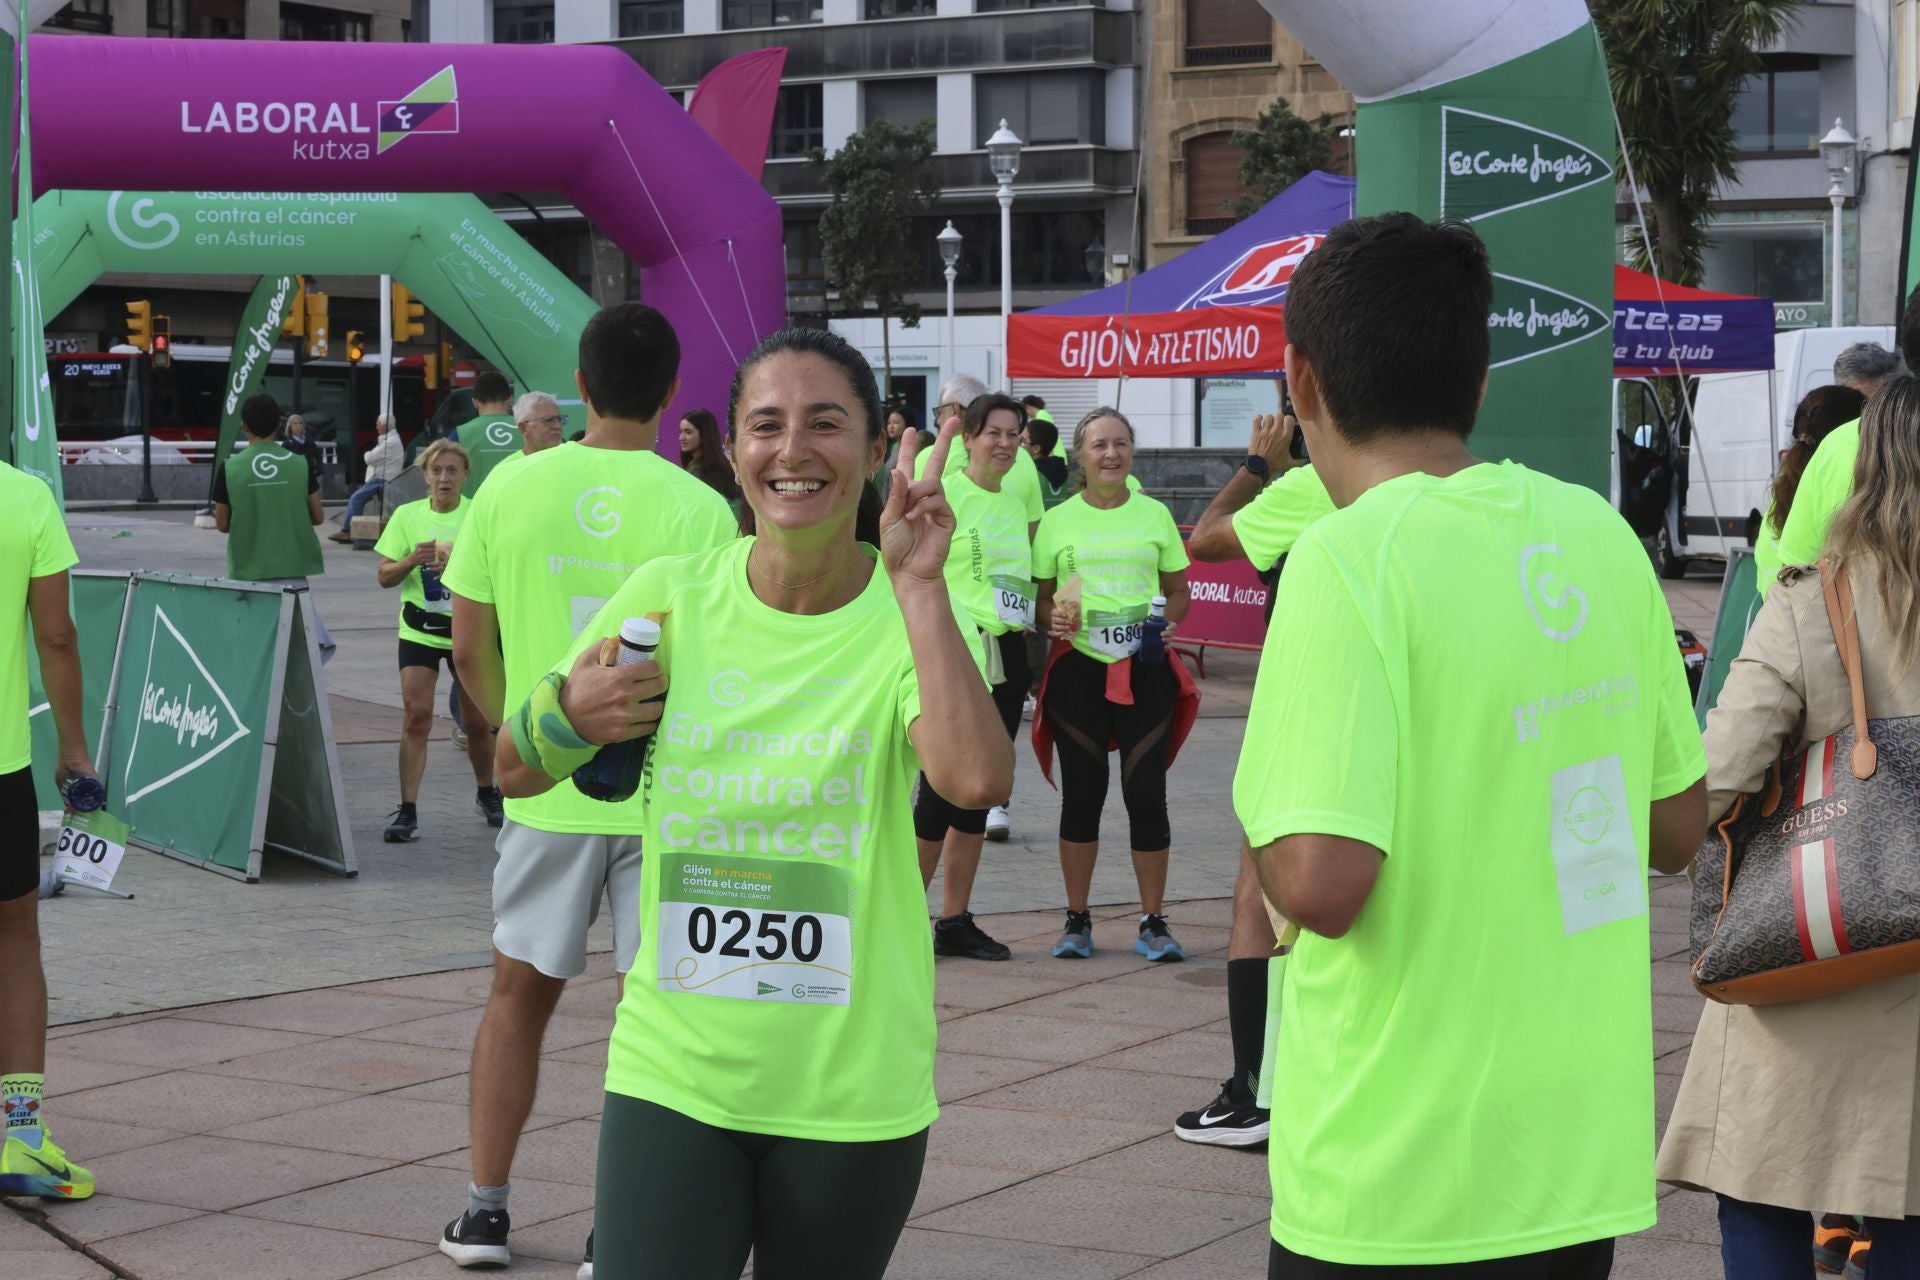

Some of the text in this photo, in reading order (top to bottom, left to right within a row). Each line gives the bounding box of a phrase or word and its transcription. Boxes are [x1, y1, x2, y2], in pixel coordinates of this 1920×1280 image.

[181, 101, 371, 134] LABORAL
[293, 139, 370, 161] kutxa
[1449, 144, 1592, 183] El Corte Inglés
[195, 207, 357, 224] contra el cáncer
[195, 230, 306, 247] en Asturias
[460, 218, 555, 305] En marcha contra
[450, 232, 561, 333] el cáncer en Asturias
[1487, 298, 1590, 337] orte Inglés
[1613, 307, 1723, 332] rte.as
[1775, 308, 1807, 322] AYO
[45, 338, 79, 353] ers
[232, 344, 260, 394] Corte
[250, 276, 290, 352] Inglés
[1060, 316, 1260, 377] GIJÓN ATLETISMO
[1613, 343, 1714, 360] e tu club
[64, 364, 79, 376] 20
[969, 527, 983, 583] ASTURIAS
[1001, 590, 1030, 616] 0247
[1187, 580, 1267, 605] BORAL kutxa
[1101, 623, 1141, 644] 1680
[143, 682, 218, 748] El Corte Inglés
[665, 712, 873, 757] En marcha
[660, 764, 870, 807] contra el
[659, 805, 872, 859] cáncer
[1781, 800, 1848, 833] GUESS
[682, 878, 772, 892] contra el cáncer
[683, 864, 773, 880] Gijón en marcha
[688, 906, 823, 963] 0250
